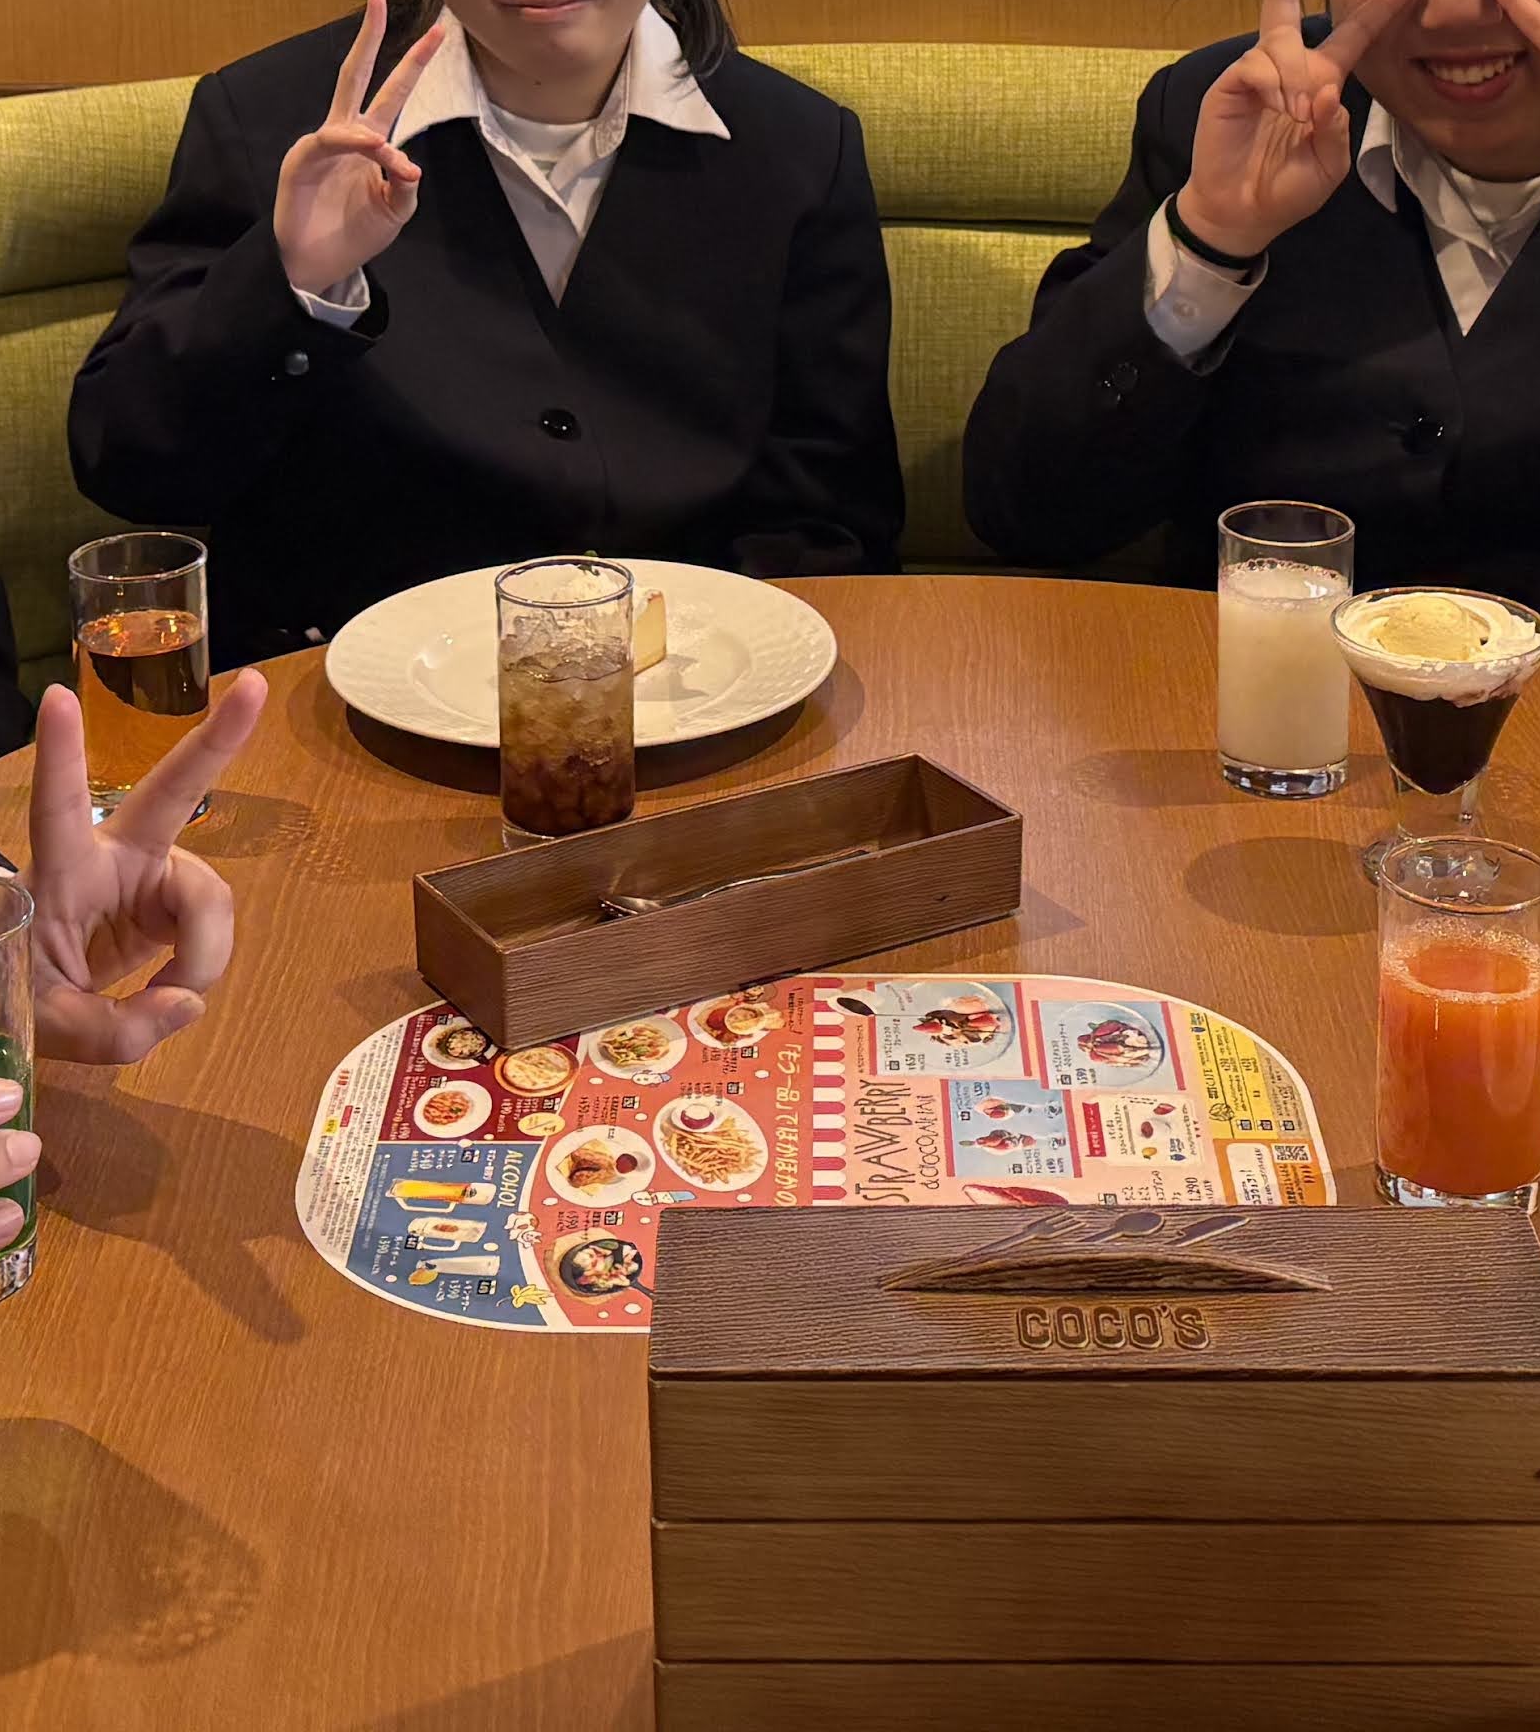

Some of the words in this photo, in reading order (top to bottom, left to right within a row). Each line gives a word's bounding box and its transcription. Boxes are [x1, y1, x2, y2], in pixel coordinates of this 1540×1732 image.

[854, 1080, 916, 1203] STRAWBERRY
[496, 1150, 524, 1208] ALCOHOL
[1016, 1306, 1211, 1352] COCO'S
